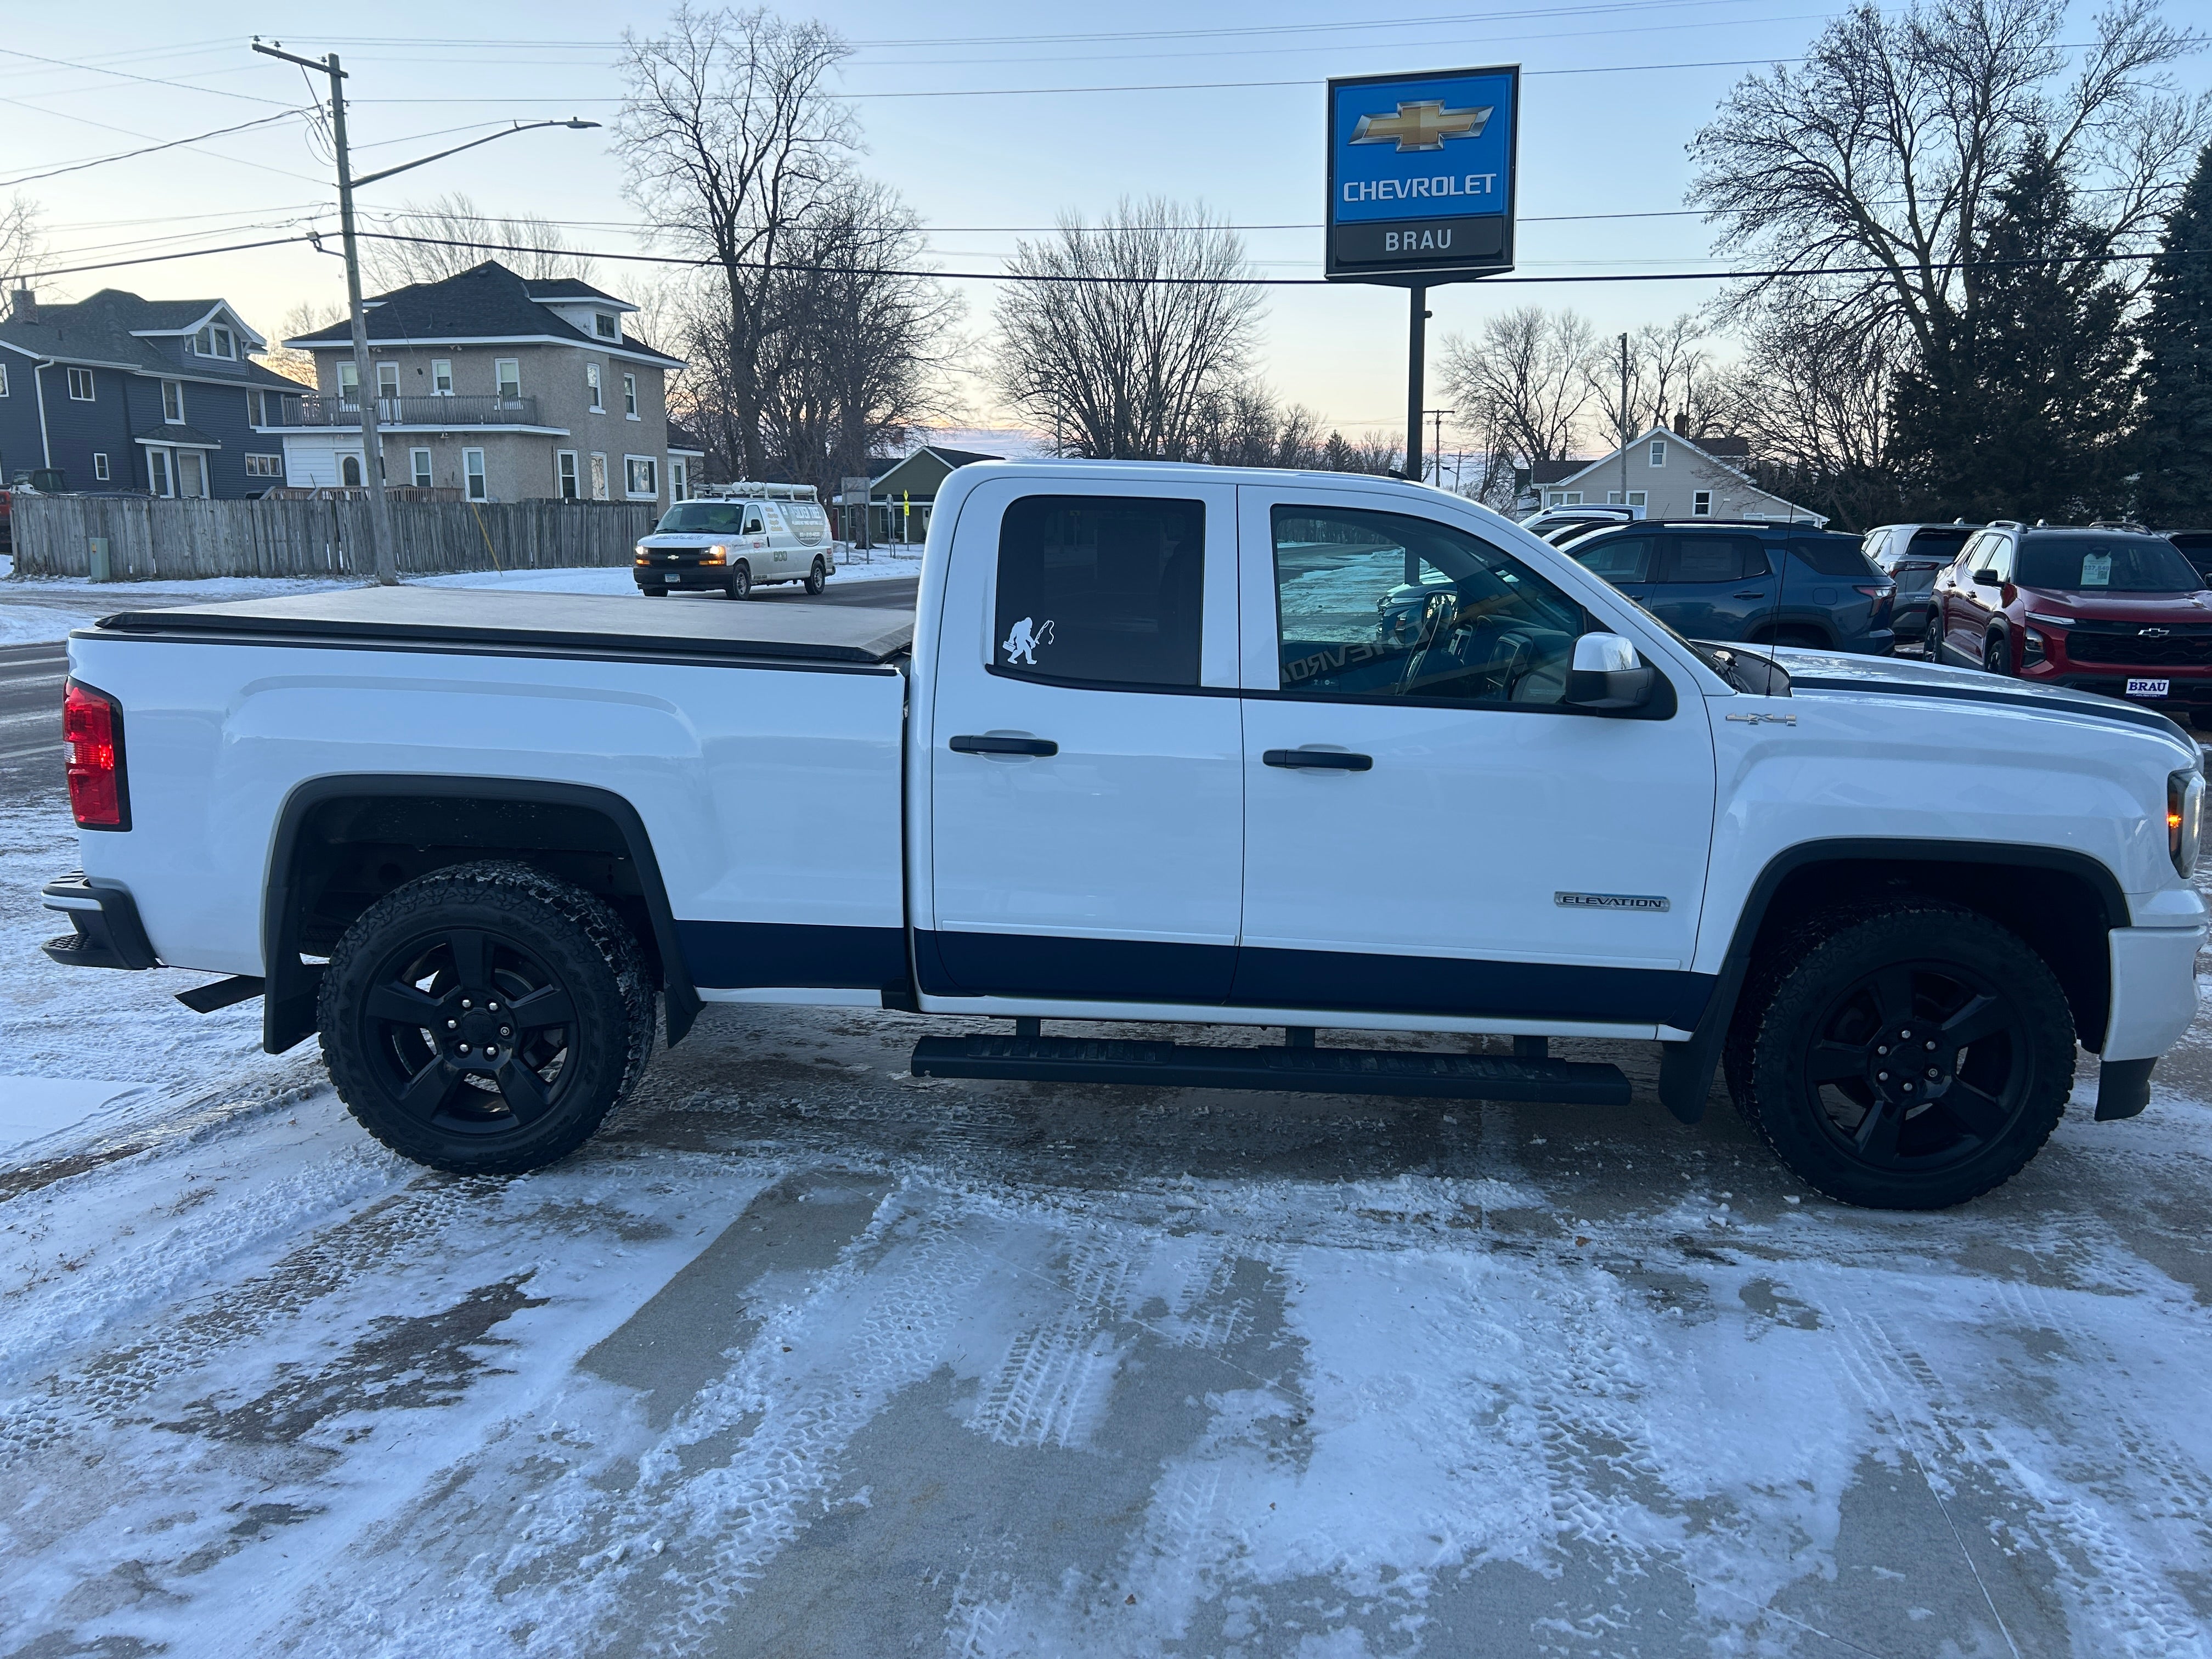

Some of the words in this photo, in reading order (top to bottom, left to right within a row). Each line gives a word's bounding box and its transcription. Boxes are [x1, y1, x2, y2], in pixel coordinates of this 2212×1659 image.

[1343, 173, 1497, 202] CHEVROLET
[1385, 229, 1452, 251] BRAU
[2128, 681, 2167, 692] BRAU
[1563, 895, 1662, 907] ELEVATION
